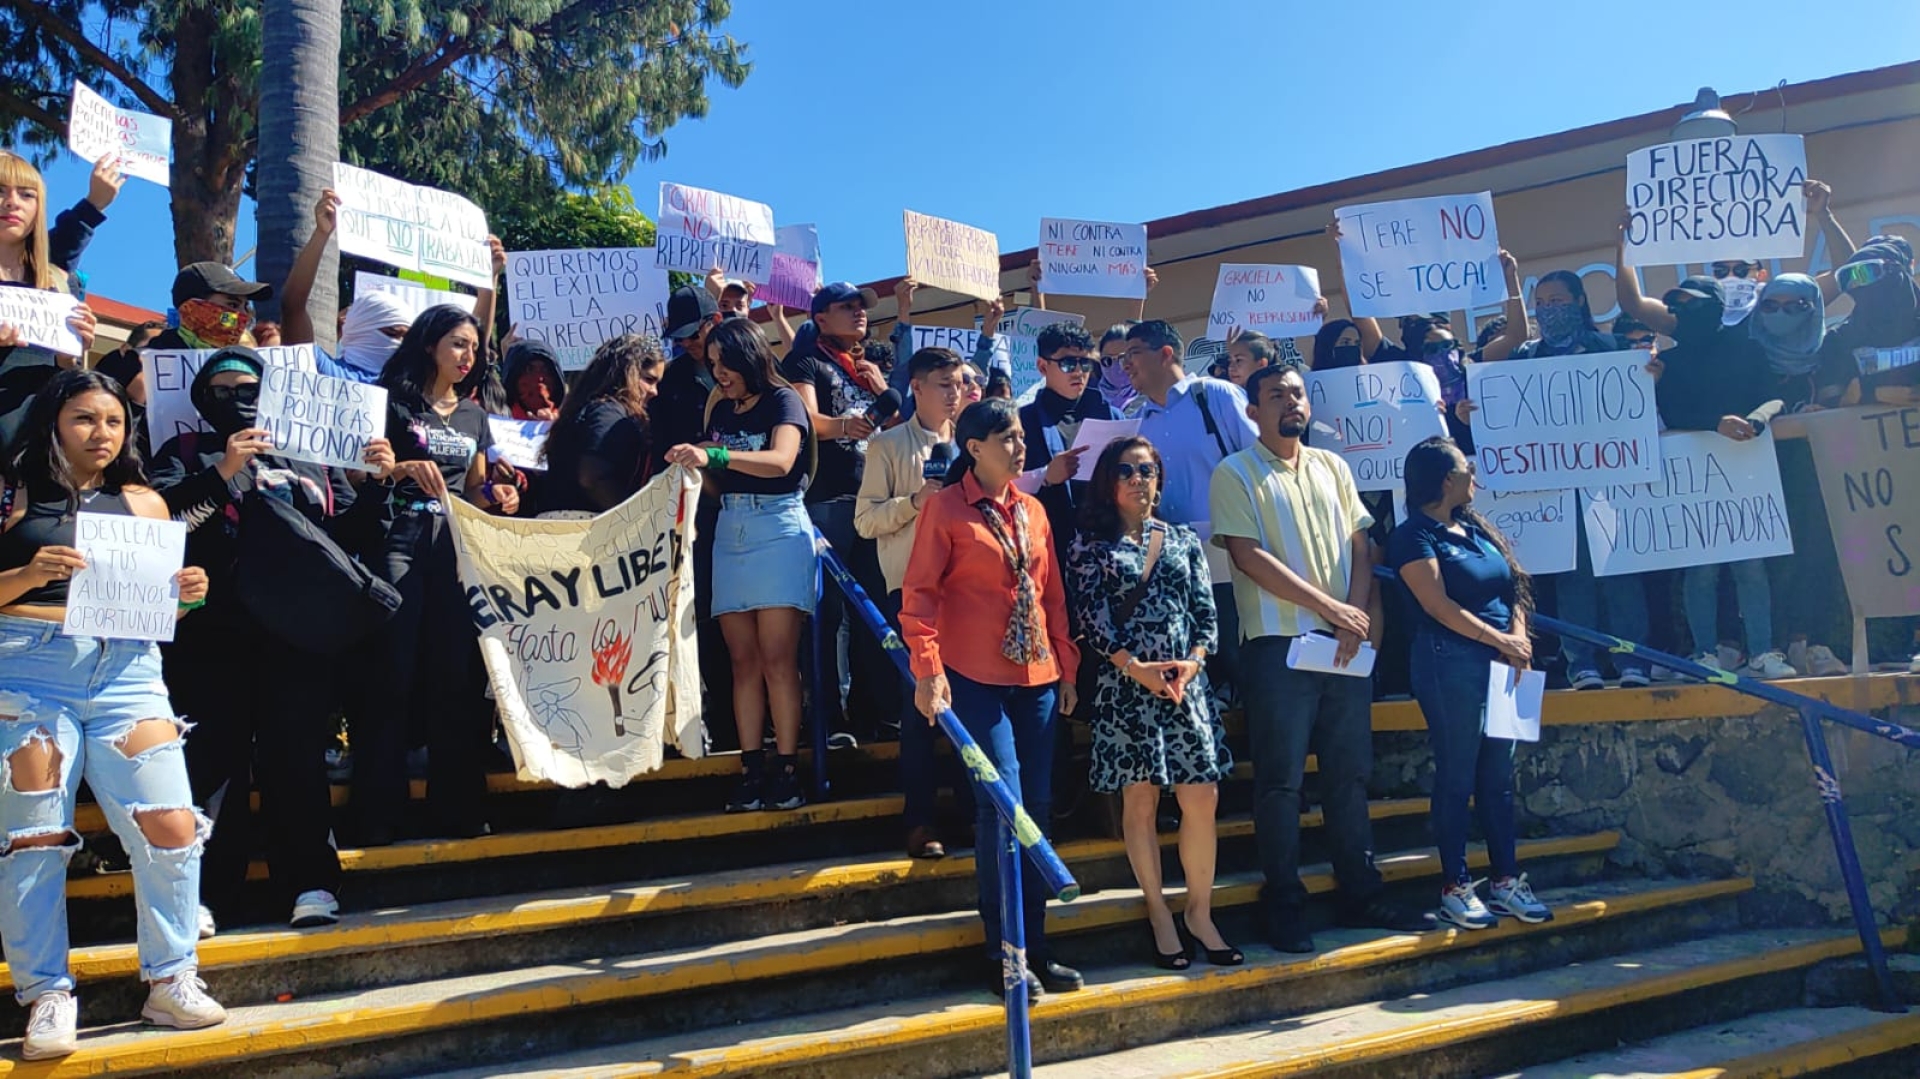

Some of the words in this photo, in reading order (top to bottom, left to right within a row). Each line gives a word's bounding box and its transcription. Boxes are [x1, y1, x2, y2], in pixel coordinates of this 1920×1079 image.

[1650, 138, 1769, 178] FUERA
[1633, 166, 1806, 208] DIRECTORA
[387, 220, 413, 250] NO
[683, 216, 712, 241] NO
[725, 221, 759, 248] NOS
[1048, 223, 1064, 241] NI
[1072, 223, 1124, 241] CONTRA
[1346, 210, 1416, 253] TERE
[1440, 203, 1485, 241] NO
[1627, 199, 1800, 246] OPRESORA
[514, 250, 639, 277] QUEREMOS
[656, 235, 761, 275] REPRESENTA
[1093, 246, 1106, 258] NI
[1108, 245, 1143, 258] CONTRA
[1048, 262, 1099, 275] NINGUNA
[1224, 269, 1285, 286] GRACIELA
[1359, 271, 1391, 299] SE
[1408, 261, 1487, 293] TOCA!
[516, 281, 545, 300] EL
[554, 271, 639, 297] EXILIO
[1247, 288, 1265, 302] NO
[523, 301, 549, 321] DE
[570, 297, 604, 318] LA
[1210, 311, 1236, 325] NOS
[914, 327, 977, 353] TERE
[268, 366, 364, 403] CIENCIAS
[1480, 364, 1645, 431] EXIGIMOS
[282, 395, 374, 434] POLITICAS
[262, 416, 378, 467] AUTONOM
[1336, 415, 1392, 445] ¡NO!
[1357, 456, 1404, 480] QUIE
[1844, 468, 1893, 512] NO
[81, 519, 168, 549] DESLEAL
[1593, 492, 1788, 555] VIOLENTADORA
[84, 547, 97, 574] A
[106, 549, 137, 571] TUS
[77, 579, 164, 605] ALUMNOS
[69, 605, 173, 634] OPORTUNISTA
[502, 623, 578, 668] Hasta
